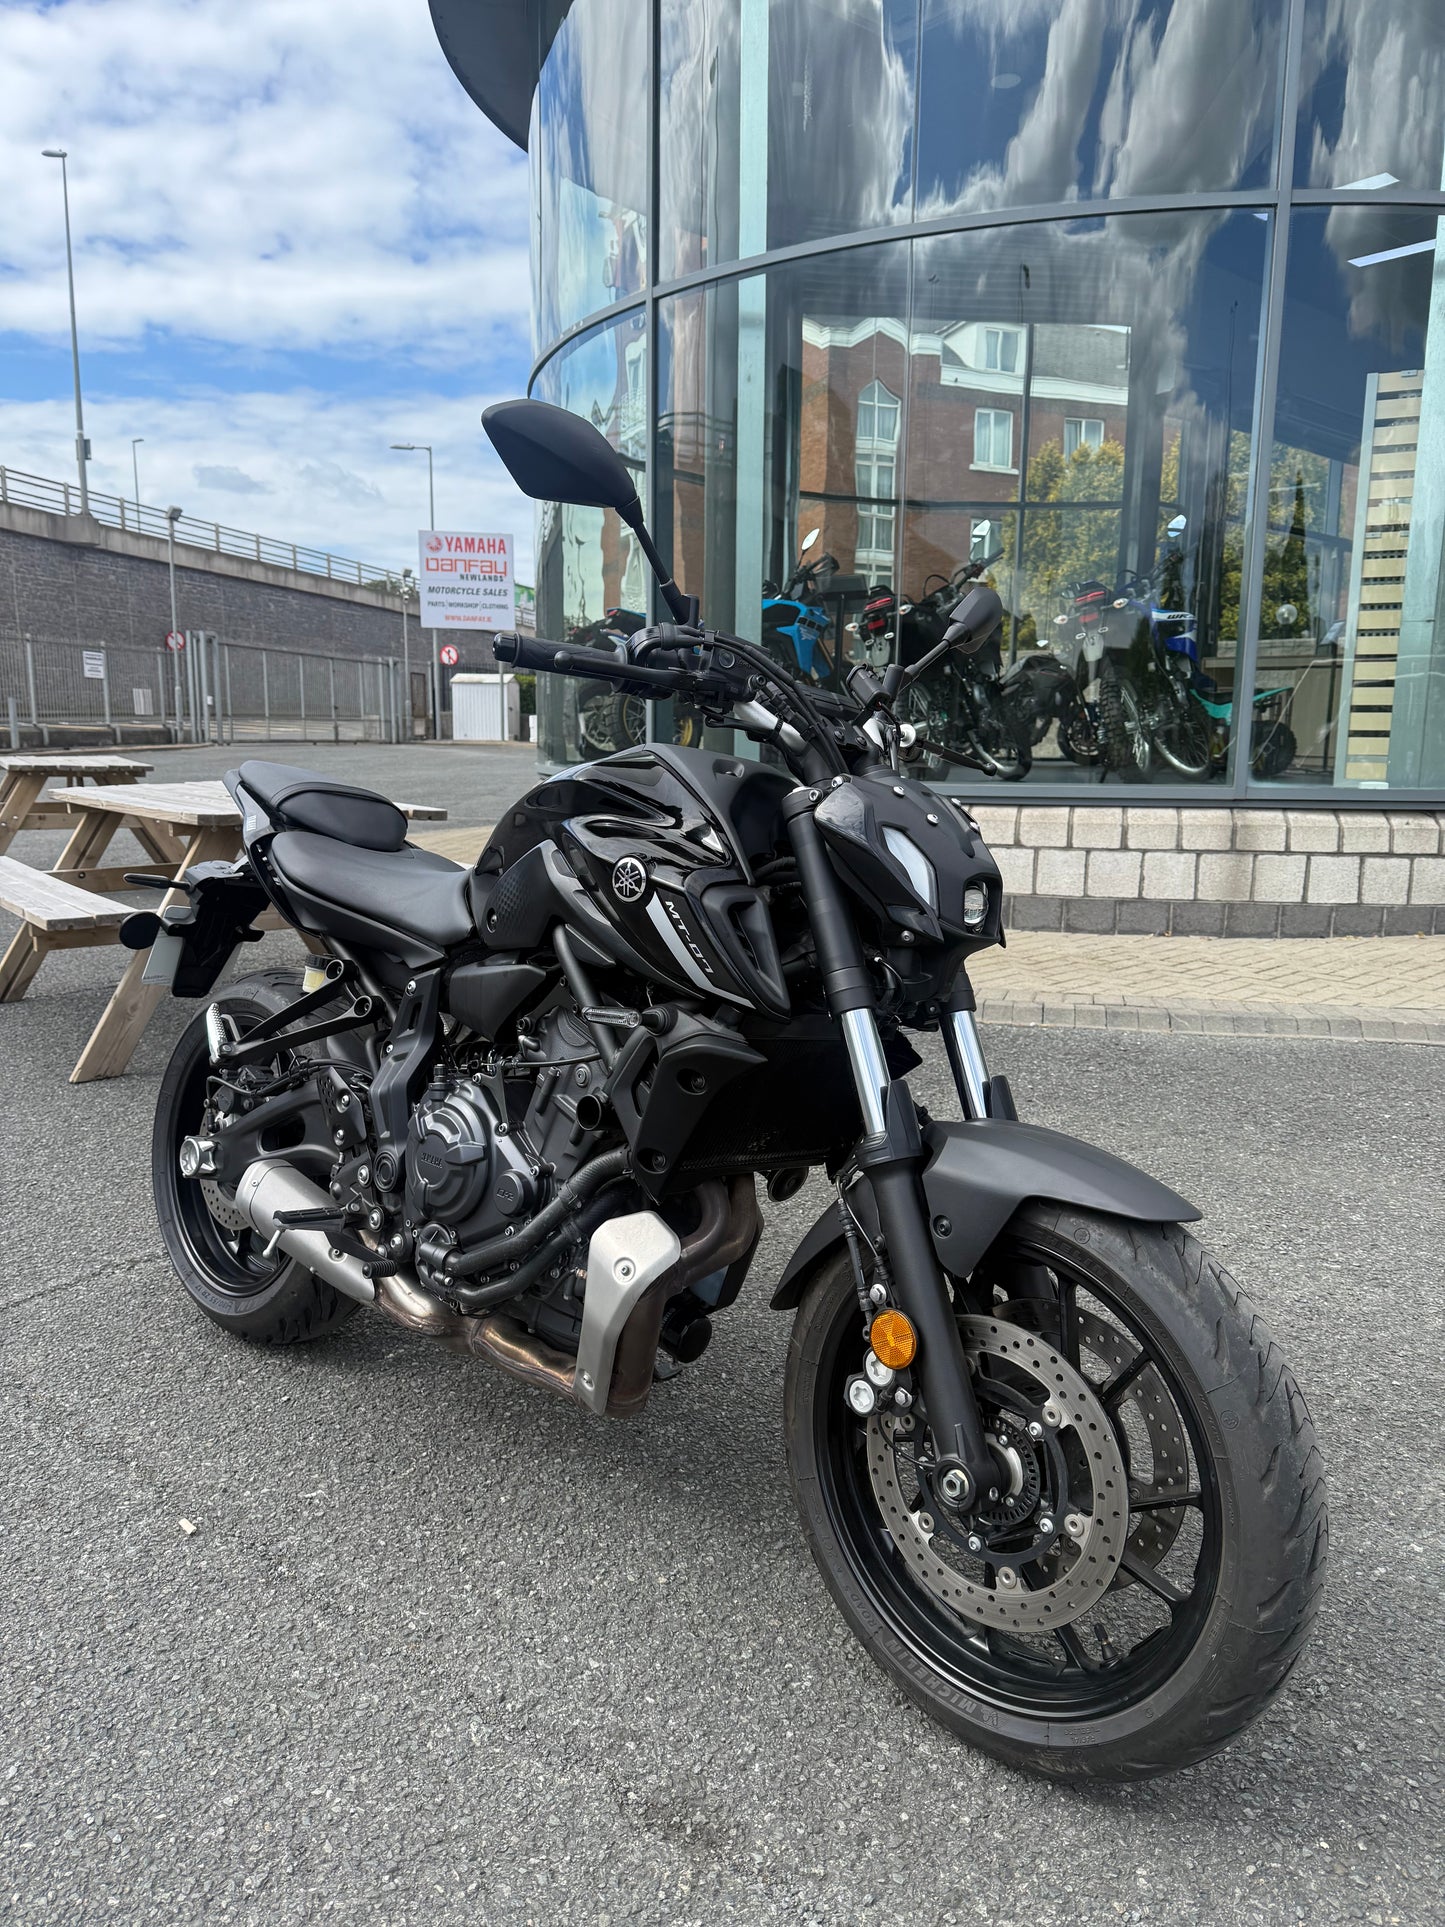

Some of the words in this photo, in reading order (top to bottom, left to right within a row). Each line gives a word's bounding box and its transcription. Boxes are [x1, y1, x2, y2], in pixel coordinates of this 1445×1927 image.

[445, 536, 507, 555] YAMAHA
[460, 574, 504, 582] NEWLANDS
[428, 586, 481, 596] MOTORCYCLE
[482, 588, 509, 597] SALES
[665, 900, 714, 975] MT-07
[851, 1593, 876, 1627] ROAD
[884, 1639, 978, 1714] MICHELIN
